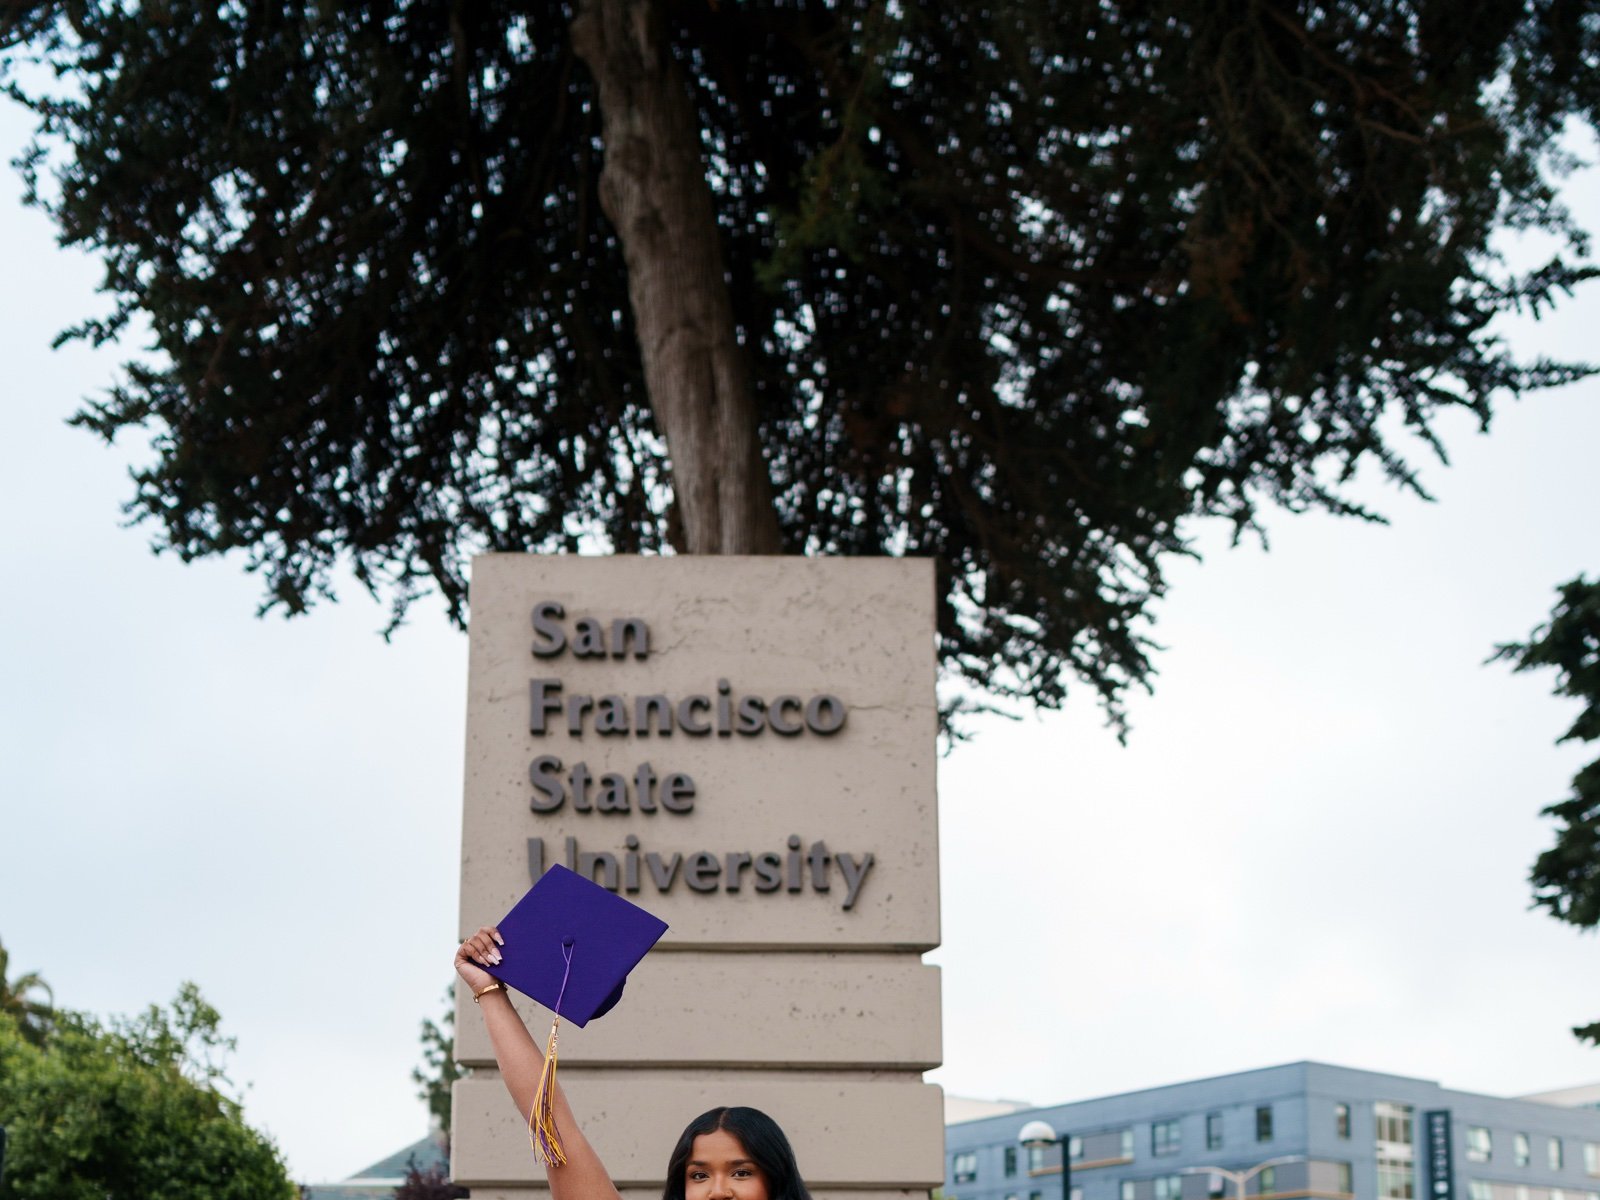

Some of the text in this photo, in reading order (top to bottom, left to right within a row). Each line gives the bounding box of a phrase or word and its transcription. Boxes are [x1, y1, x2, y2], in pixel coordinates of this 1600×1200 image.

[530, 600, 650, 659] San
[528, 677, 847, 737] Francisco
[528, 755, 697, 813] State
[526, 834, 875, 910] University
